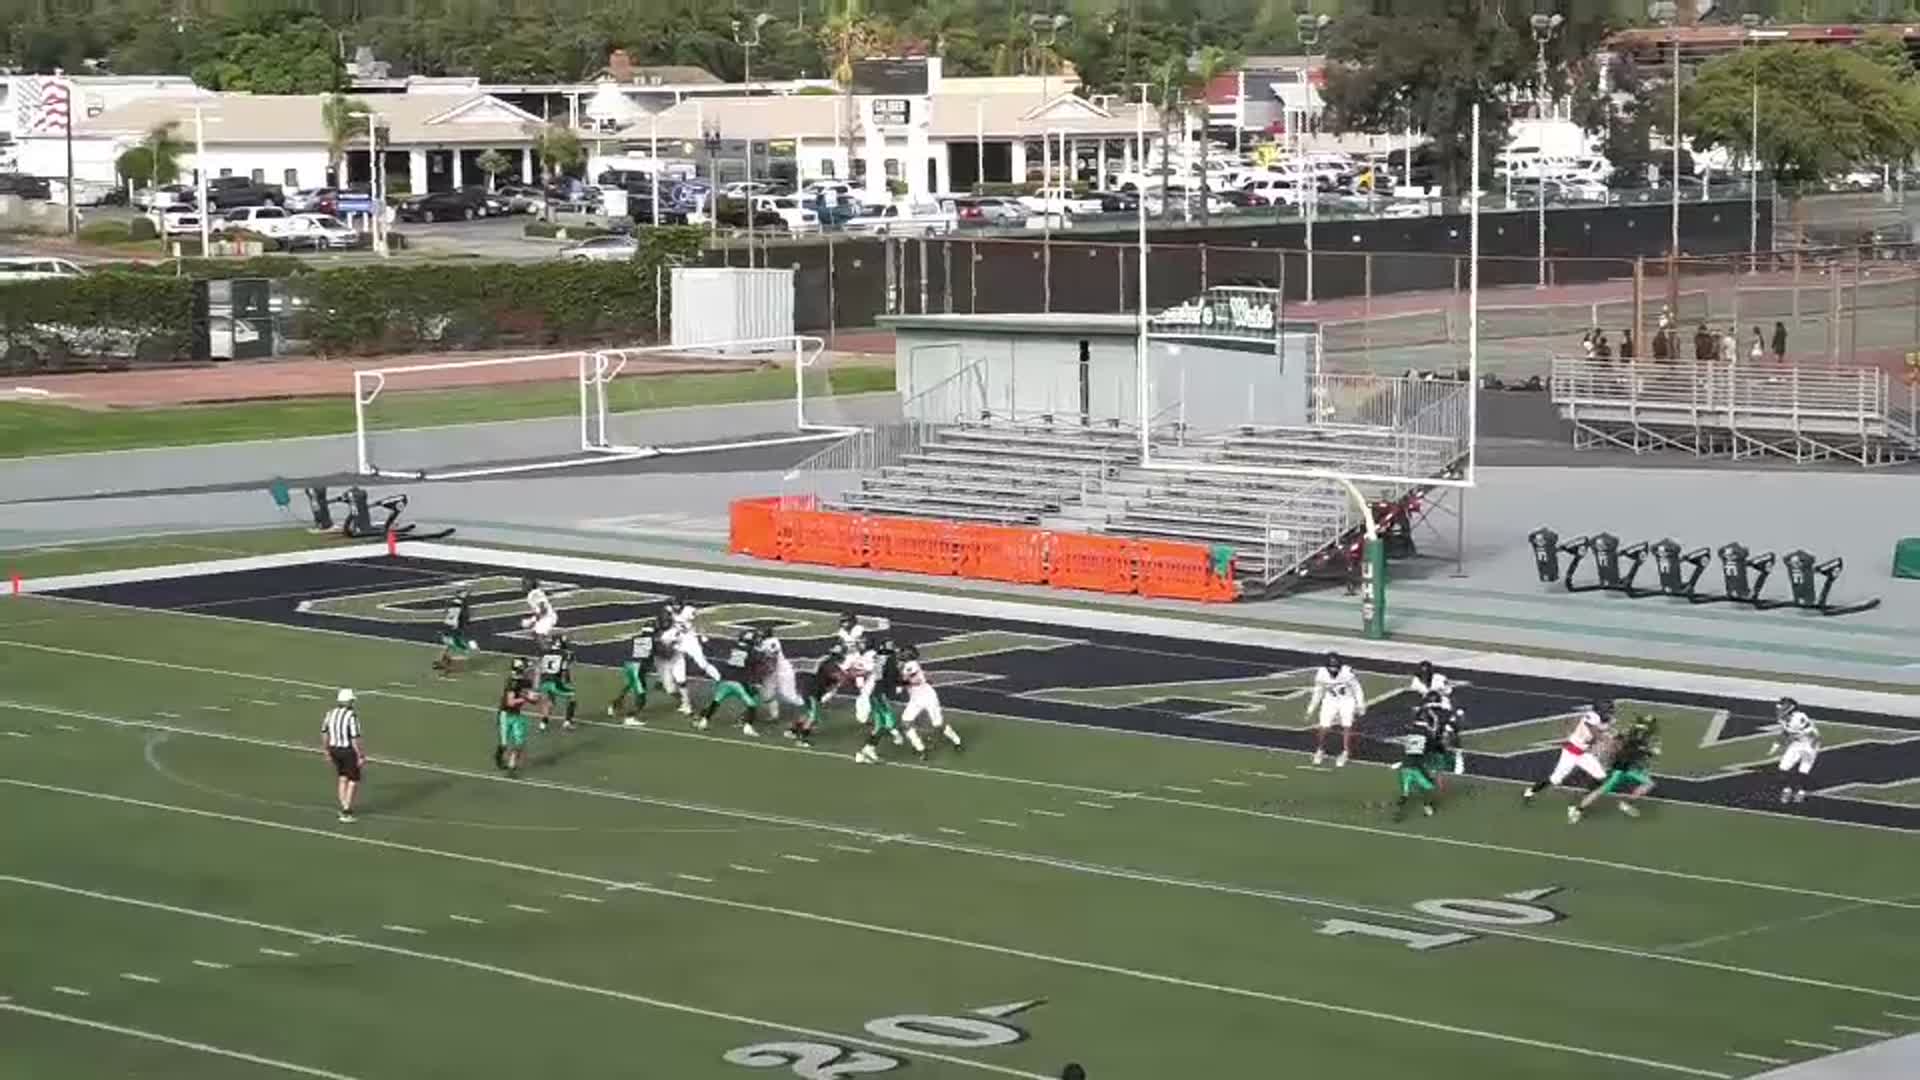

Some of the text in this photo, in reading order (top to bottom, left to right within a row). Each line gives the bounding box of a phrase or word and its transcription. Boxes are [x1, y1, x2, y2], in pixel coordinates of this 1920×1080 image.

[299, 575, 1920, 804] UPLAN
[1312, 898, 1556, 950] 10
[722, 1014, 1021, 1080] 20
